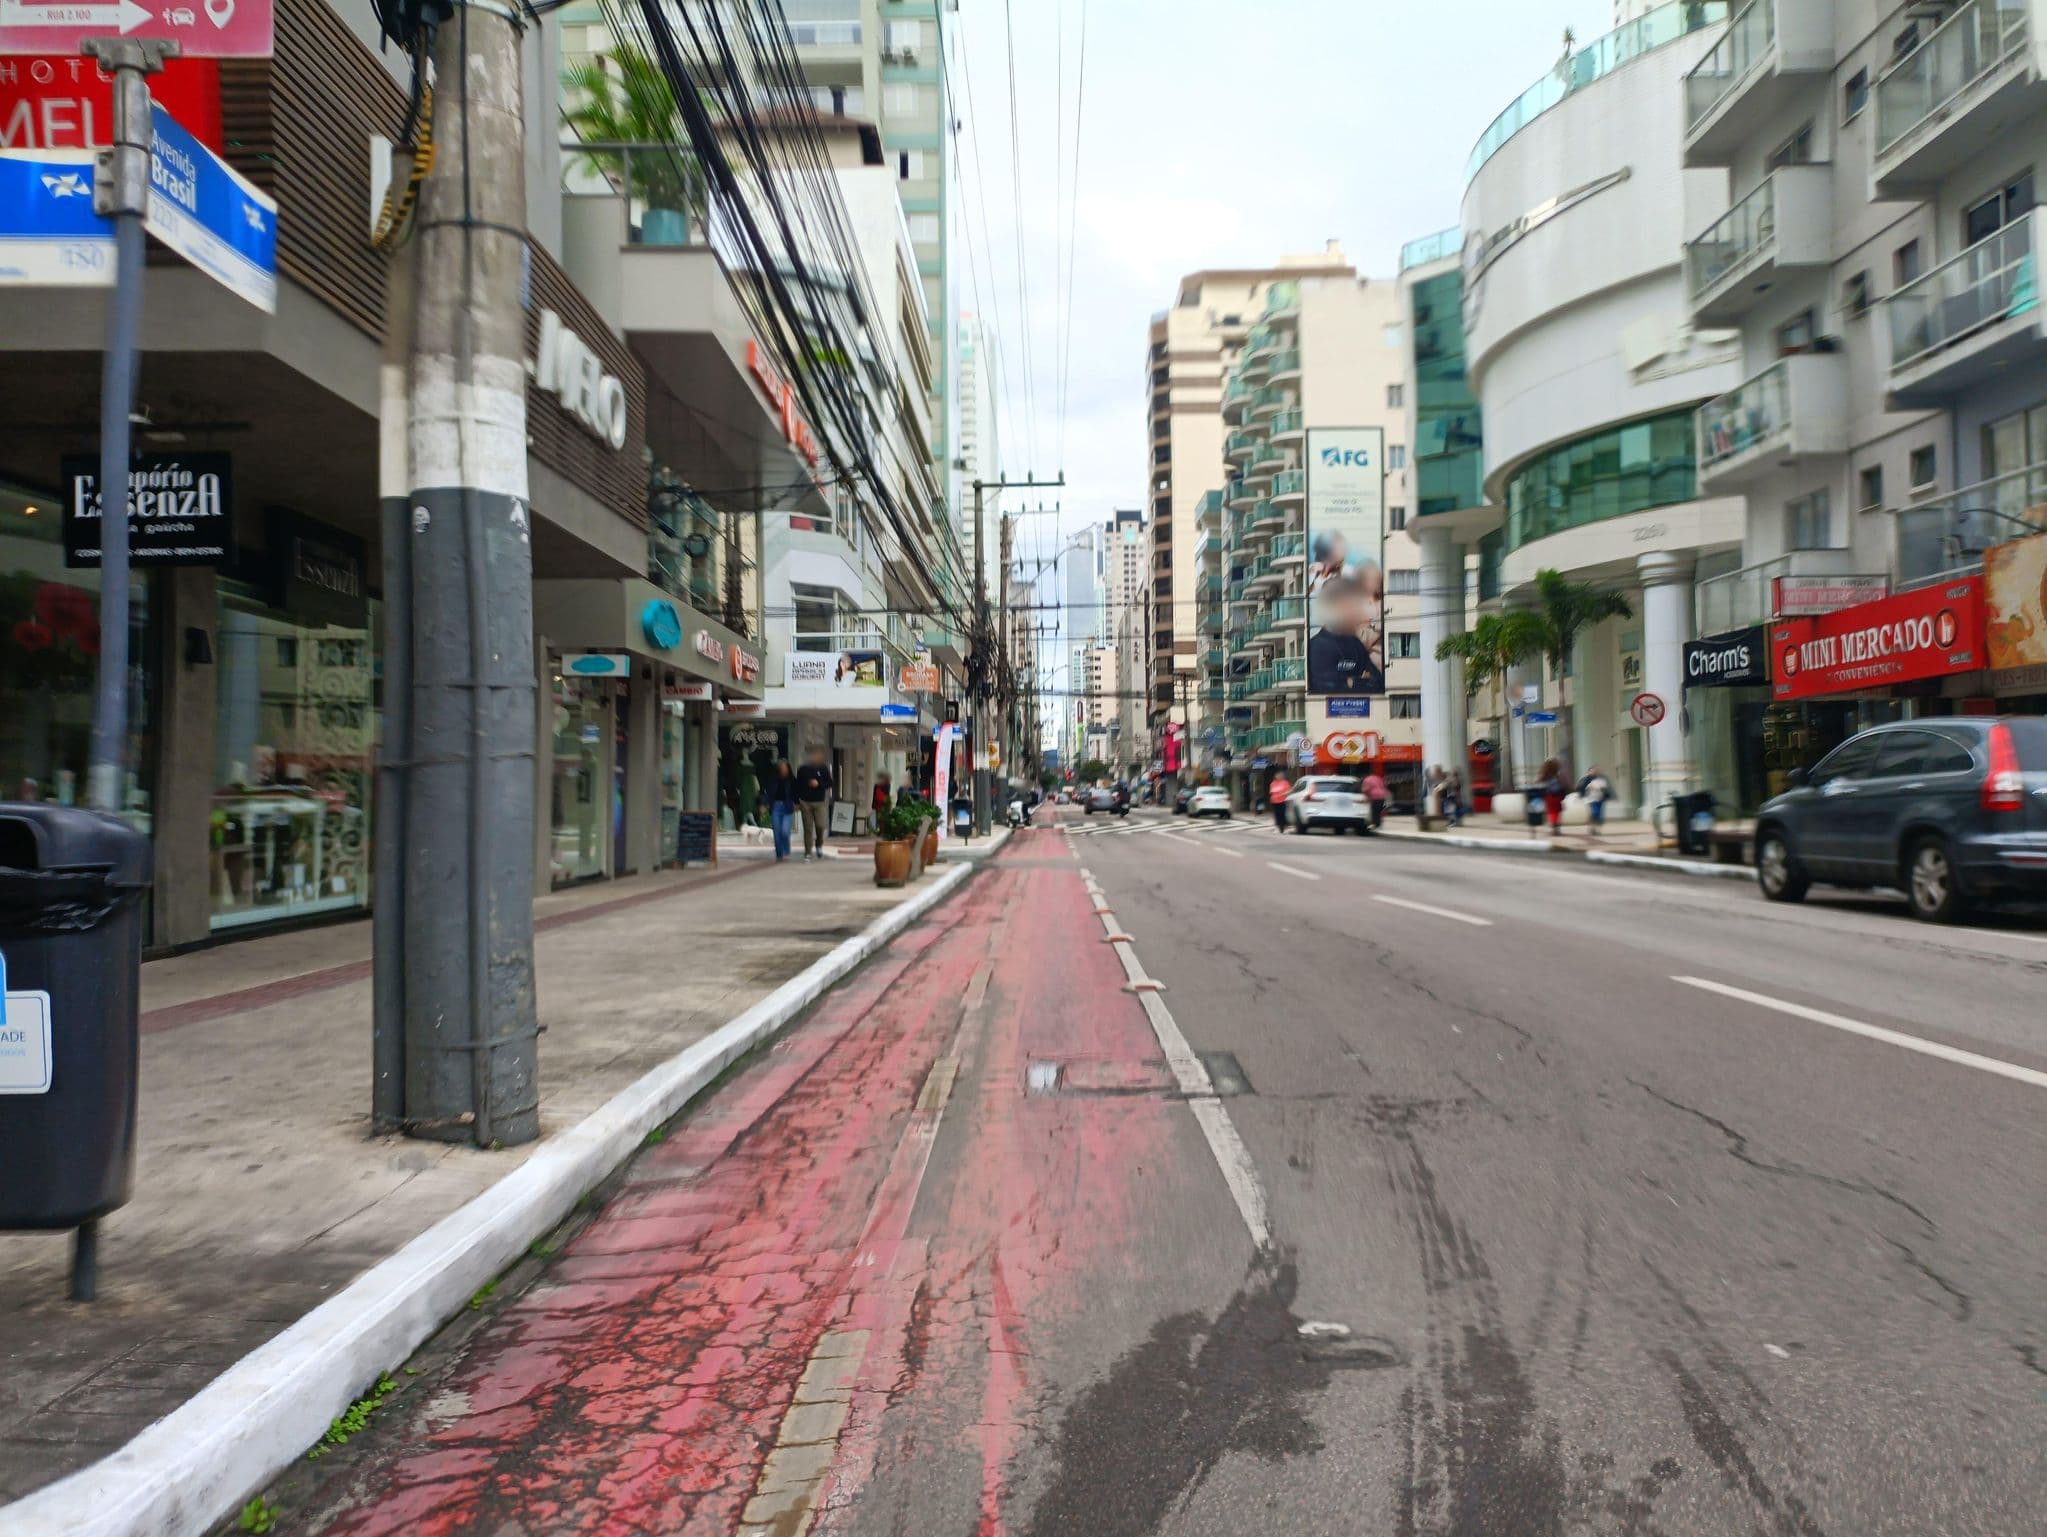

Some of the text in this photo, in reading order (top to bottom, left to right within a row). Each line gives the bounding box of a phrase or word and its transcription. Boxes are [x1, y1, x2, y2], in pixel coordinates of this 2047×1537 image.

[151, 128, 196, 183] Avenida
[151, 153, 197, 213] Brasil
[791, 661, 826, 669] LUANA
[1689, 644, 1751, 677] Charm's
[1800, 613, 1934, 672] MINI MERCADO
